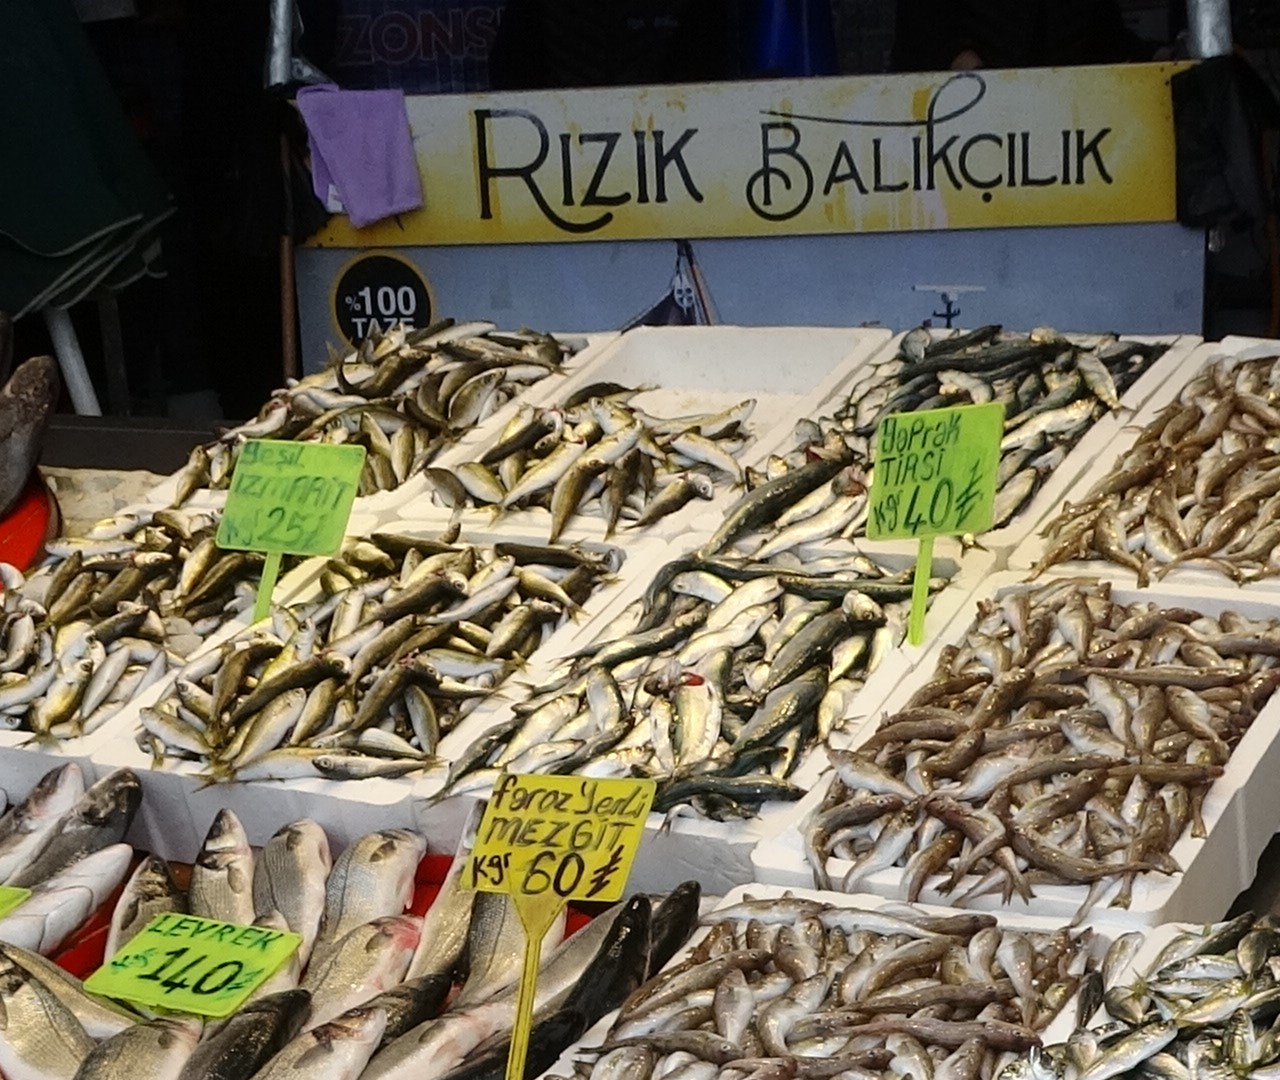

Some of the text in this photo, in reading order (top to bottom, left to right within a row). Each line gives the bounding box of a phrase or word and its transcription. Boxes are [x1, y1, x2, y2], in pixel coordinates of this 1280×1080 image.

[475, 74, 1112, 233] RIZIK BALIKÇILIK
[345, 286, 417, 317] %100
[148, 914, 284, 951] LEVREK
